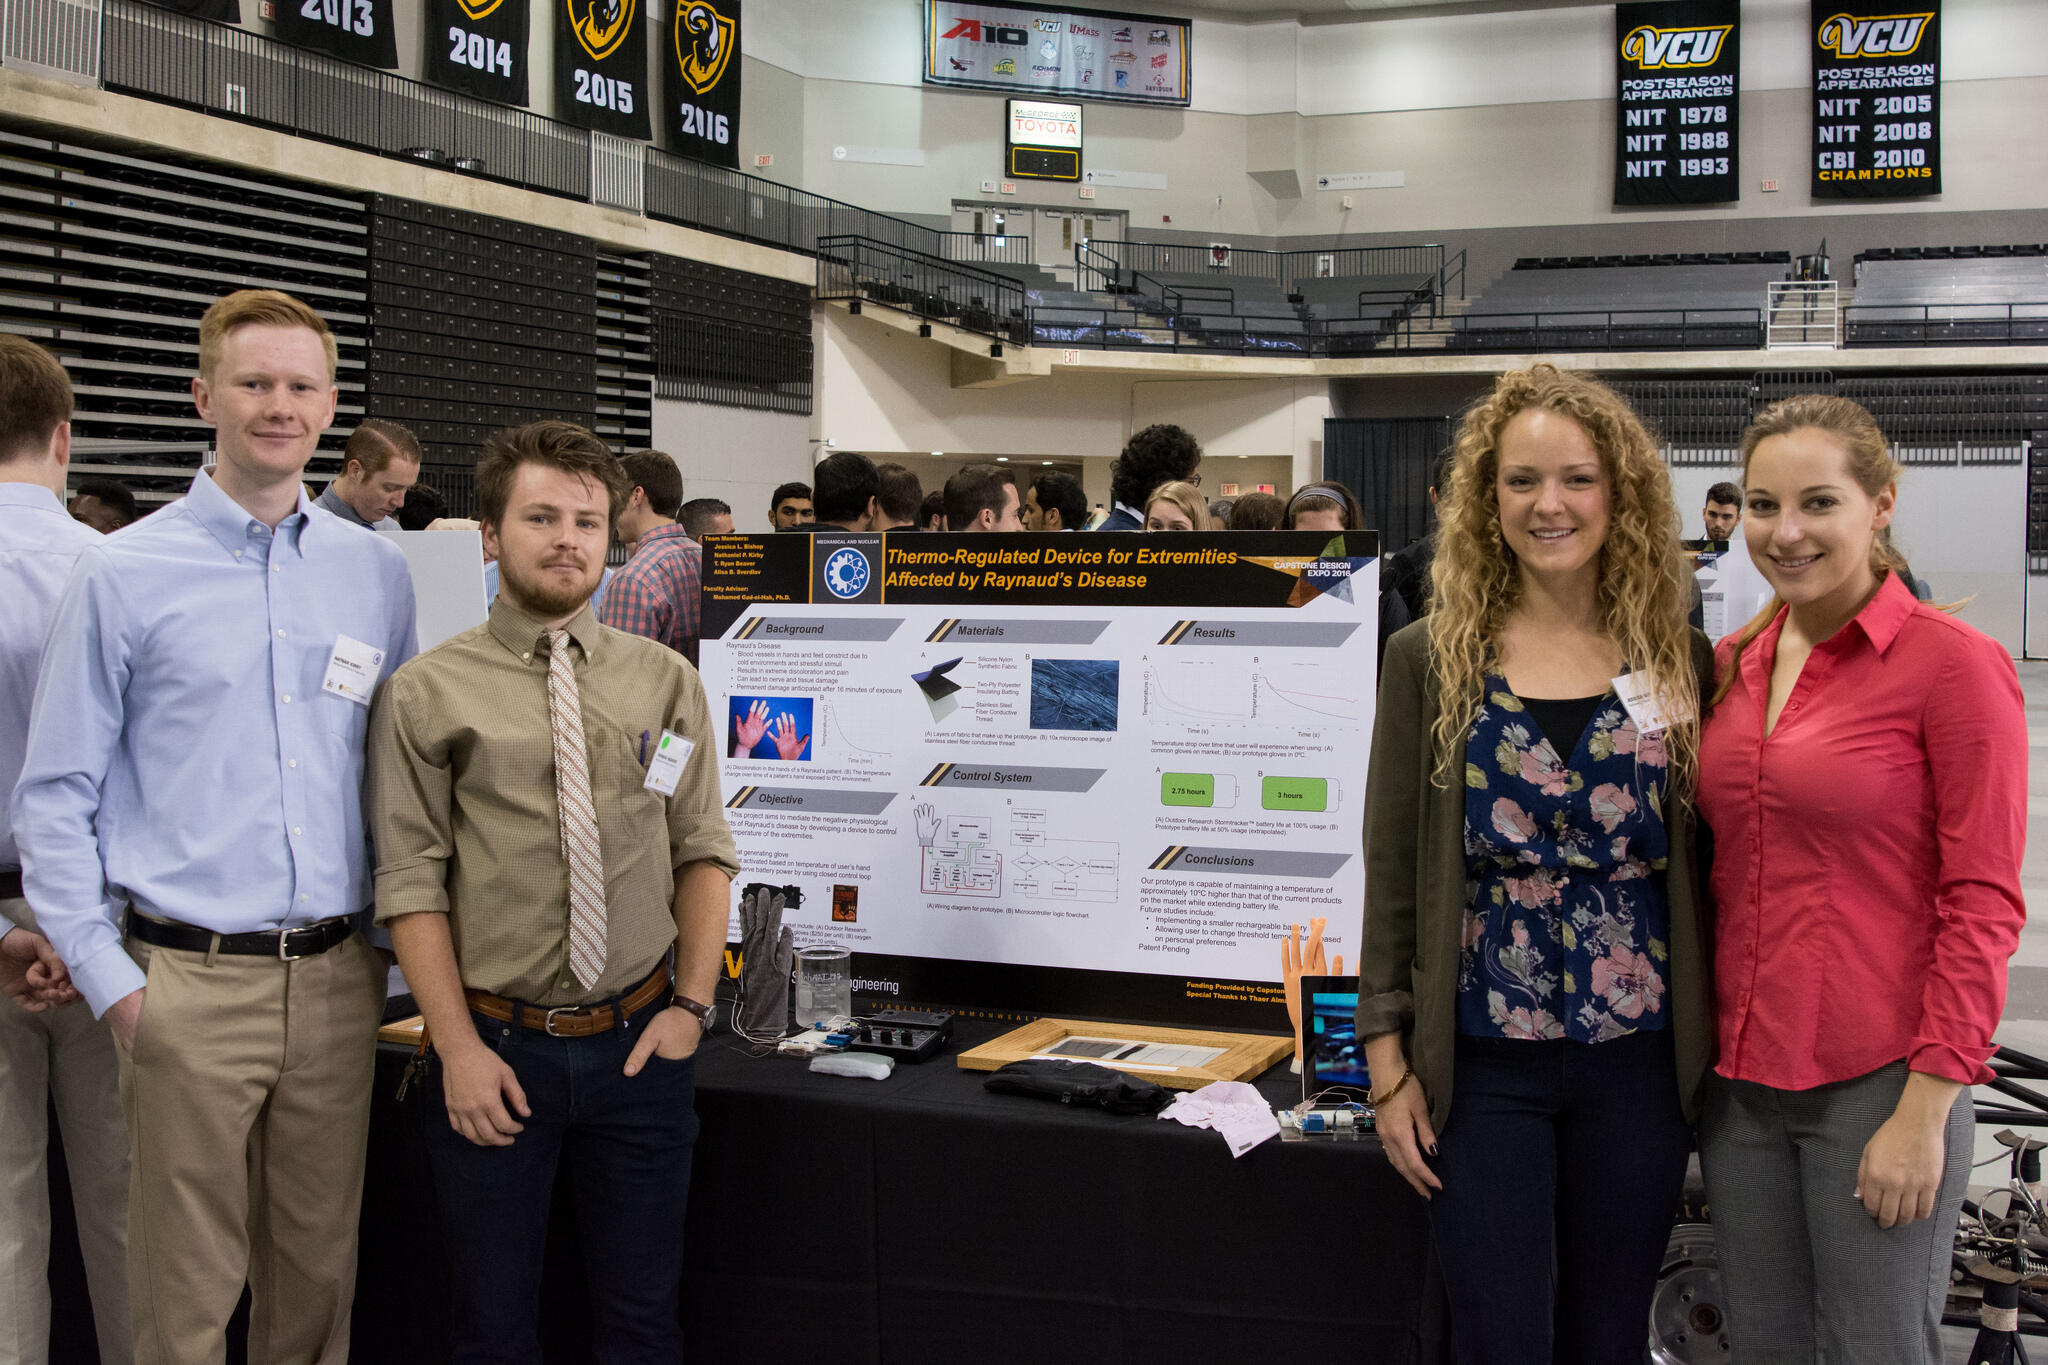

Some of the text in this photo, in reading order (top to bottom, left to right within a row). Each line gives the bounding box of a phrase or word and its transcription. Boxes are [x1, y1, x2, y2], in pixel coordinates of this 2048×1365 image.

[301, 0, 374, 36] 2013
[1036, 20, 1062, 32] VCU
[1822, 17, 1924, 54] VCU
[450, 26, 512, 78] 2014
[1626, 29, 1724, 64] VCU
[1818, 64, 1934, 80] POSTSEASON
[1622, 75, 1733, 90] POSTSEASON
[1818, 76, 1934, 90] APPEARANCES
[574, 68, 633, 114] 2015
[1622, 86, 1733, 101] APPEARANCES
[1819, 95, 1931, 116] NIT 2005
[1626, 106, 1727, 126] NIT 1978
[681, 103, 729, 144] 2016
[1016, 119, 1076, 134] TOYOTA
[1819, 122, 1931, 143] NIT 2008
[1626, 132, 1729, 152] NIT 1988
[758, 155, 770, 165] EXIT
[1818, 149, 1925, 169] CBI 2010
[1626, 158, 1729, 178] NIT 1993
[1818, 168, 1932, 181] CHAMPIONS
[1002, 183, 1014, 193] EXIT
[1064, 350, 1078, 364] EXIT
[1222, 484, 1235, 495] EXIT
[748, 552, 763, 560] Kirby
[888, 548, 1237, 568] Thermo-Regulated Device for Extremities
[719, 560, 734, 568] Ryan
[1307, 569, 1351, 577] EXPO 2016
[886, 572, 1147, 591] Affected by Raynaud's Disease
[703, 585, 724, 593] Faculty
[766, 624, 824, 636] Background
[958, 626, 1004, 636] Materials
[1194, 628, 1235, 638] Results
[757, 642, 781, 650] Disease
[953, 770, 1032, 784] Control System
[1171, 787, 1205, 796] 2.75 hours
[759, 793, 803, 805] Objective
[730, 810, 742, 818] This
[743, 811, 763, 821] project
[764, 812, 778, 820] aims
[786, 813, 810, 822] mediate
[811, 814, 821, 822] the
[822, 815, 848, 825] negative
[848, 816, 888, 827] physiological
[1185, 853, 1254, 867] Conclusions
[1140, 877, 1153, 886] Our
[1155, 879, 1186, 889] prototype
[1188, 880, 1194, 888] is
[1196, 880, 1223, 890] capable
[1224, 881, 1232, 889] of
[1233, 882, 1273, 893] maintaining
[1281, 884, 1324, 894] temperature
[1326, 885, 1333, 894] of
[1140, 888, 1187, 899] approximately
[1208, 890, 1229, 901] higher
[1231, 891, 1246, 900] than
[1248, 892, 1261, 900] that
[1263, 892, 1270, 901] of
[1272, 893, 1283, 901] the
[1284, 894, 1309, 902] current
[1311, 895, 1342, 905] products
[935, 903, 950, 912] Wiring
[951, 904, 971, 913] diagram
[1139, 905, 1215, 917] Future studies include:
[1150, 896, 1161, 905] the
[1162, 897, 1187, 906] market
[1187, 898, 1206, 907] while
[1206, 900, 1241, 911] extending
[1242, 900, 1267, 912] battery
[1267, 902, 1280, 911] life.
[1155, 915, 1200, 928] Implementing
[1208, 918, 1233, 927] smaller
[1235, 920, 1280, 931] rechargeable
[1164, 936, 1194, 946] personal
[1196, 937, 1236, 947] preferences
[1138, 942, 1189, 956] Patent Pending
[850, 976, 899, 995] gineering
[1186, 981, 1285, 995] Funding Provided by Capston
[1186, 990, 1211, 999] Special
[1213, 992, 1238, 1000] Thanks
[1270, 996, 1286, 1004] Alm
[872, 1002, 1038, 1022] VIRGINIA OMMONWEALT
